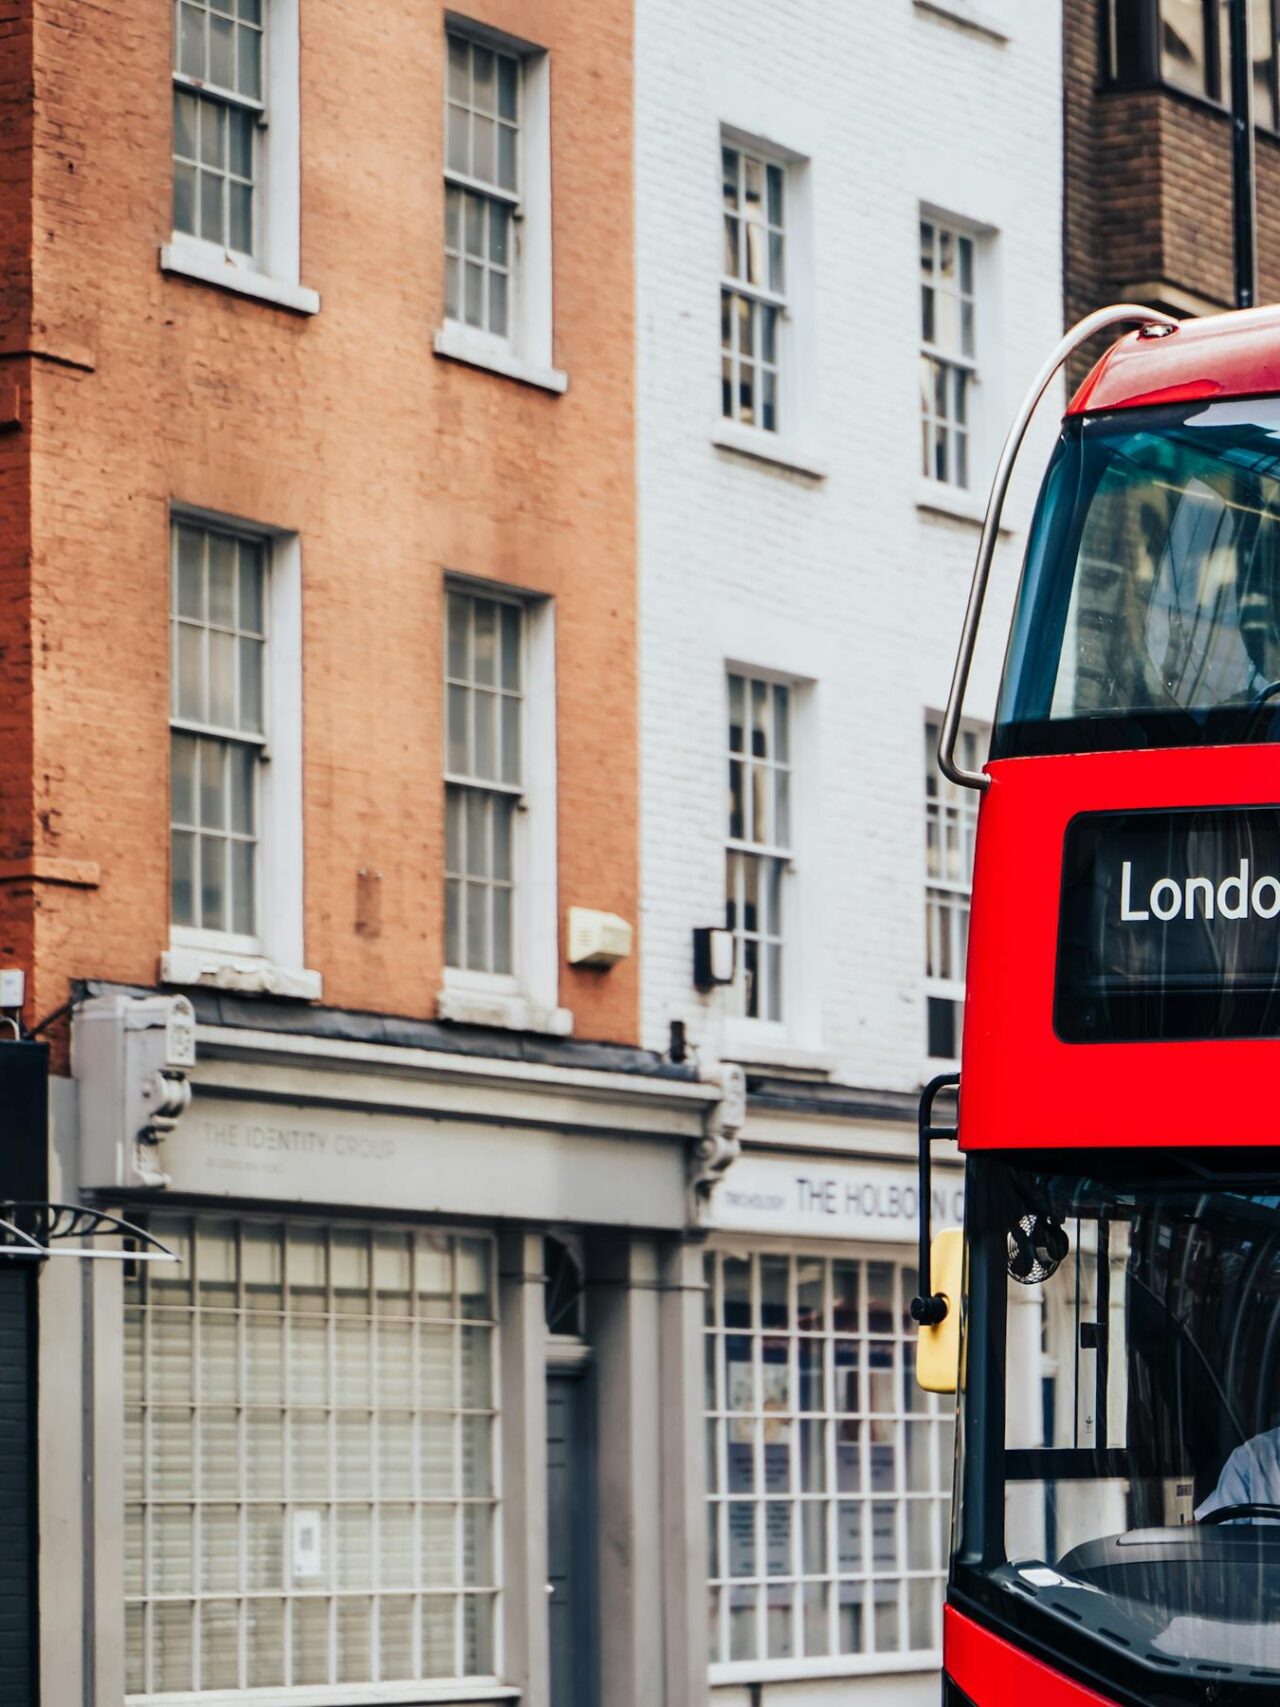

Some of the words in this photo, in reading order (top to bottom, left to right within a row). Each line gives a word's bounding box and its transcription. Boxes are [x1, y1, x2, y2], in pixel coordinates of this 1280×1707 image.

[204, 1122, 238, 1148] THE
[246, 1126, 328, 1152] IDENTITY
[335, 1134, 396, 1159] GROUP
[796, 1177, 837, 1214] THE
[848, 1183, 945, 1220] HOLBON
